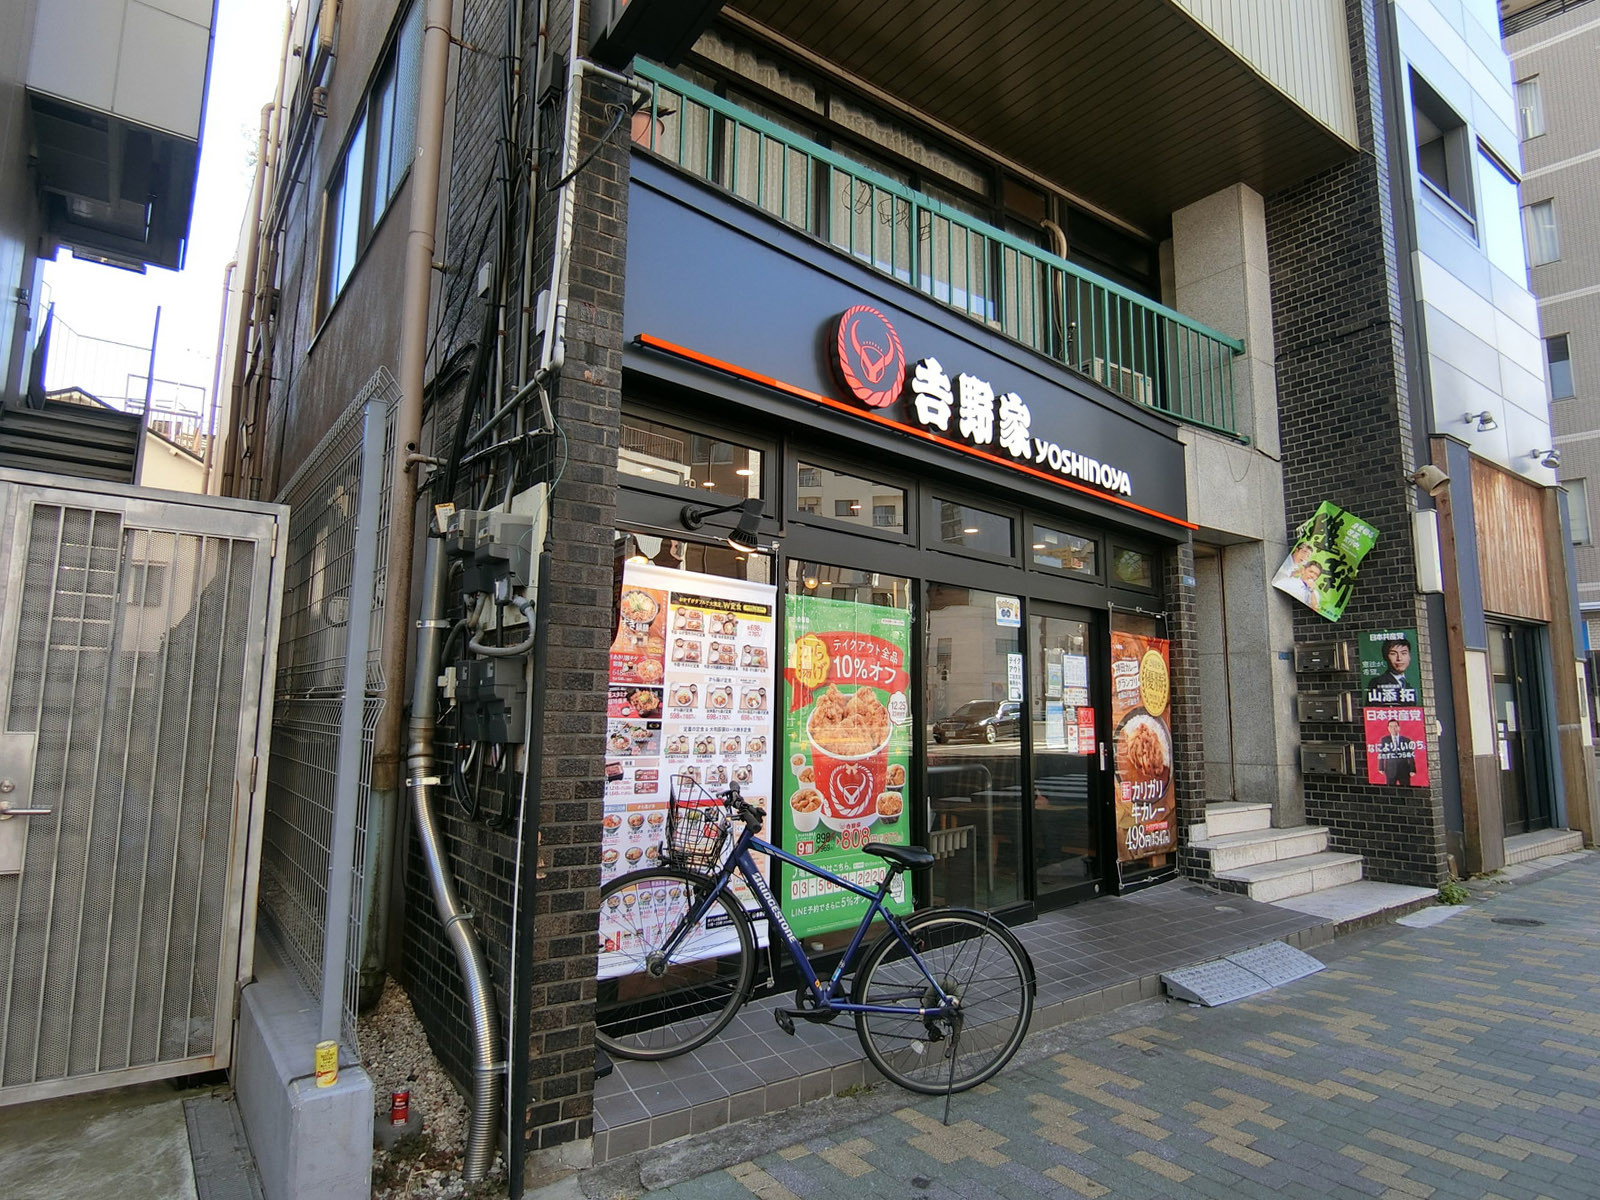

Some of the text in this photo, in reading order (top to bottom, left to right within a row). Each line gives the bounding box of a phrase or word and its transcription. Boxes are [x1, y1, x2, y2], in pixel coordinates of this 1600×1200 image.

[911, 357, 1031, 460] 吉野家
[1035, 438, 1132, 497] YOSHINOYA
[1370, 632, 1404, 641] 日本共産党
[833, 639, 898, 664] テイクアウト全品
[833, 654, 897, 684] 10%オフ
[1368, 688, 1415, 702] 山添 拓
[1366, 709, 1421, 721] 日本共産党
[1368, 740, 1426, 753] なにより、いのち。
[1132, 778, 1163, 801] カリガリ
[1131, 802, 1165, 824] 牛カレー
[752, 872, 796, 944] BRIDGESTONE
